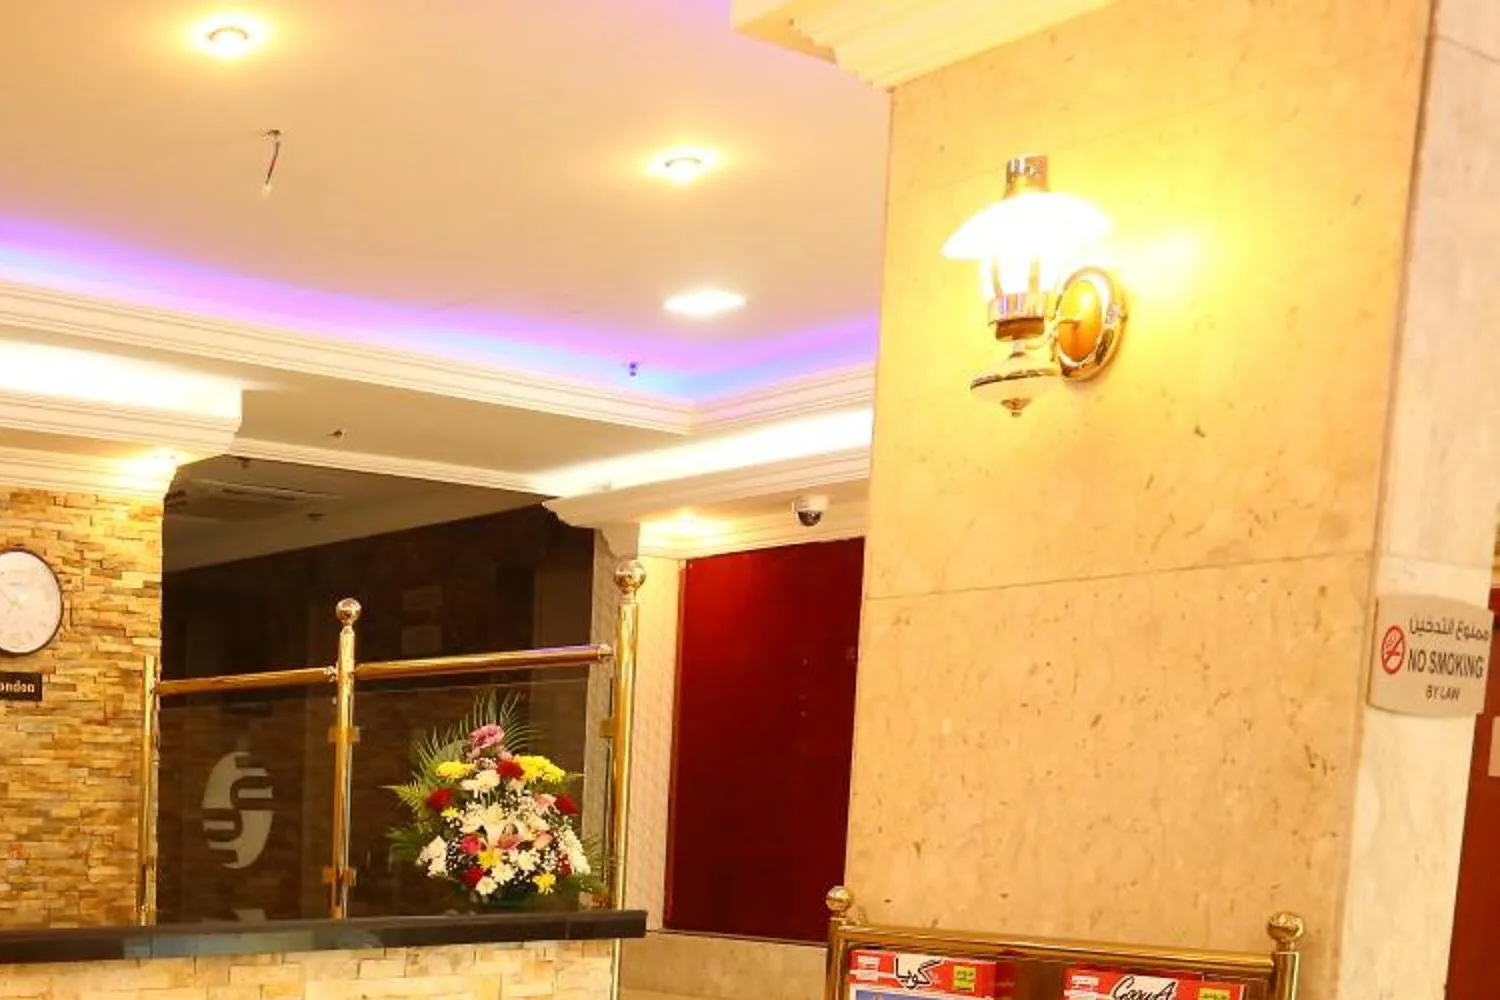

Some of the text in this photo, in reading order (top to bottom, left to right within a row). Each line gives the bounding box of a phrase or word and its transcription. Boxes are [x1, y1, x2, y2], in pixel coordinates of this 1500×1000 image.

[1407, 648, 1485, 679] NO SMOKING
[1426, 685, 1460, 701] BY LAW
